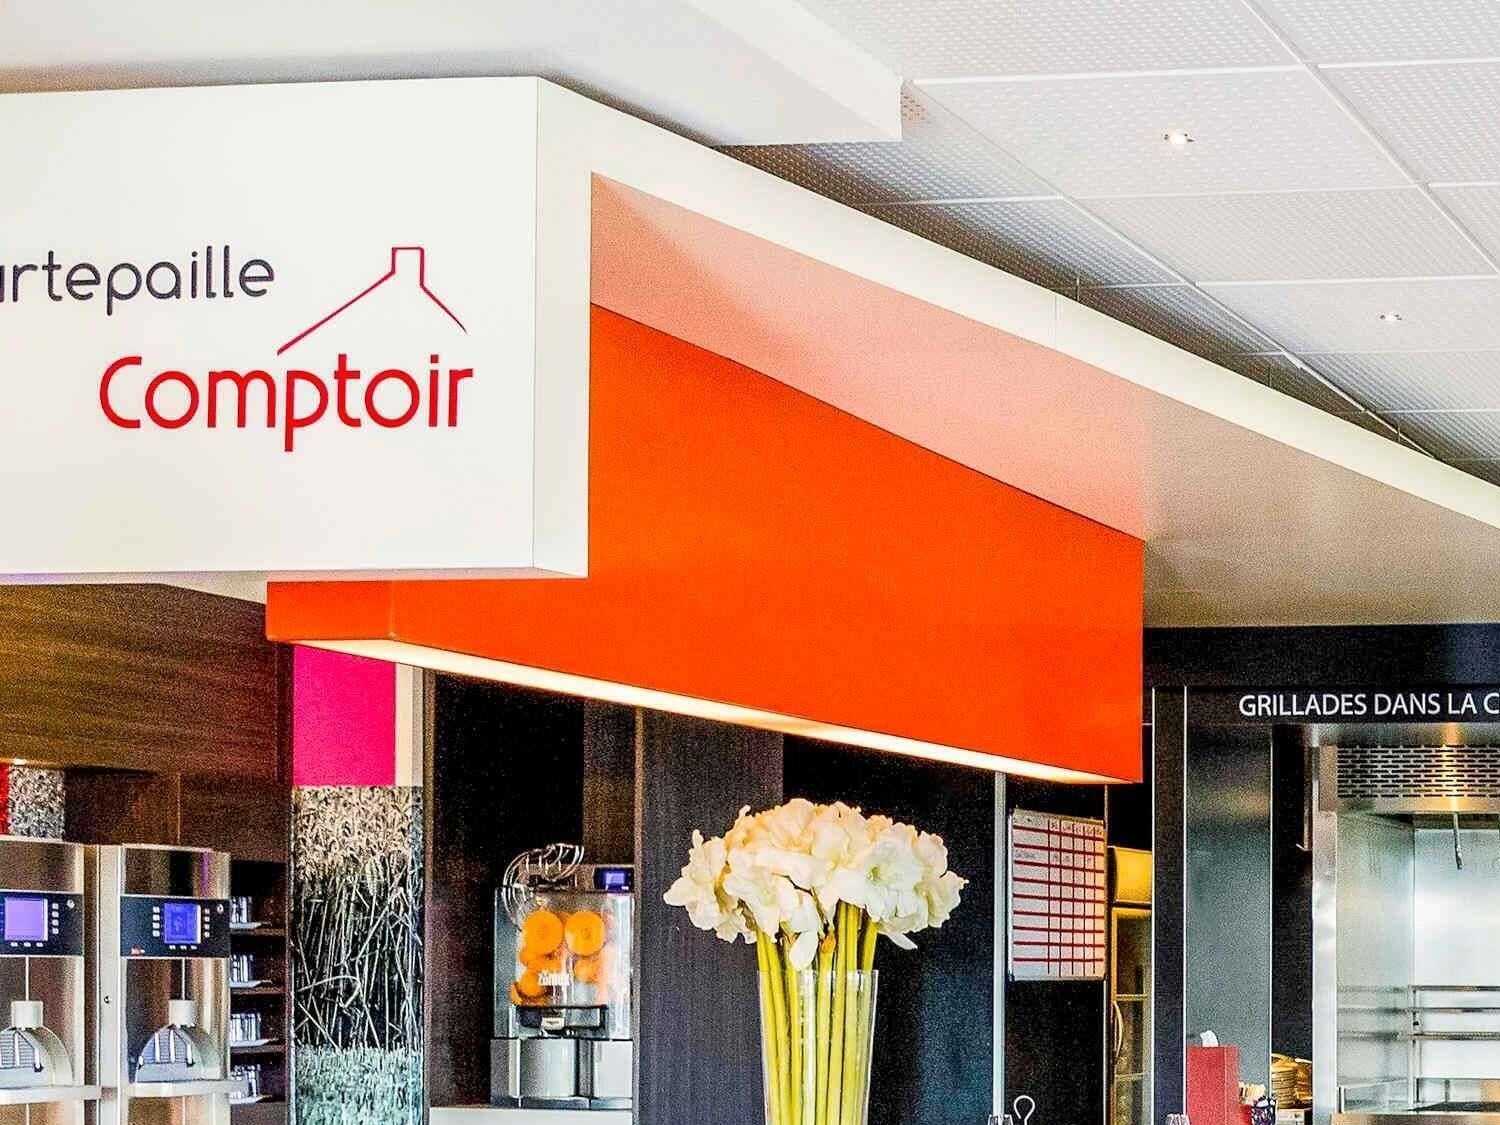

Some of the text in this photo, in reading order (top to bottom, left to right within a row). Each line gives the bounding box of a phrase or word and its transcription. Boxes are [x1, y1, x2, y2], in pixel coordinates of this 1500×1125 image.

[0, 245, 275, 316] rtepaille
[99, 353, 474, 453] Comptoir
[1238, 693, 1367, 717] GRILLADES
[1374, 693, 1441, 715] DANS
[1447, 692, 1478, 715] LA
